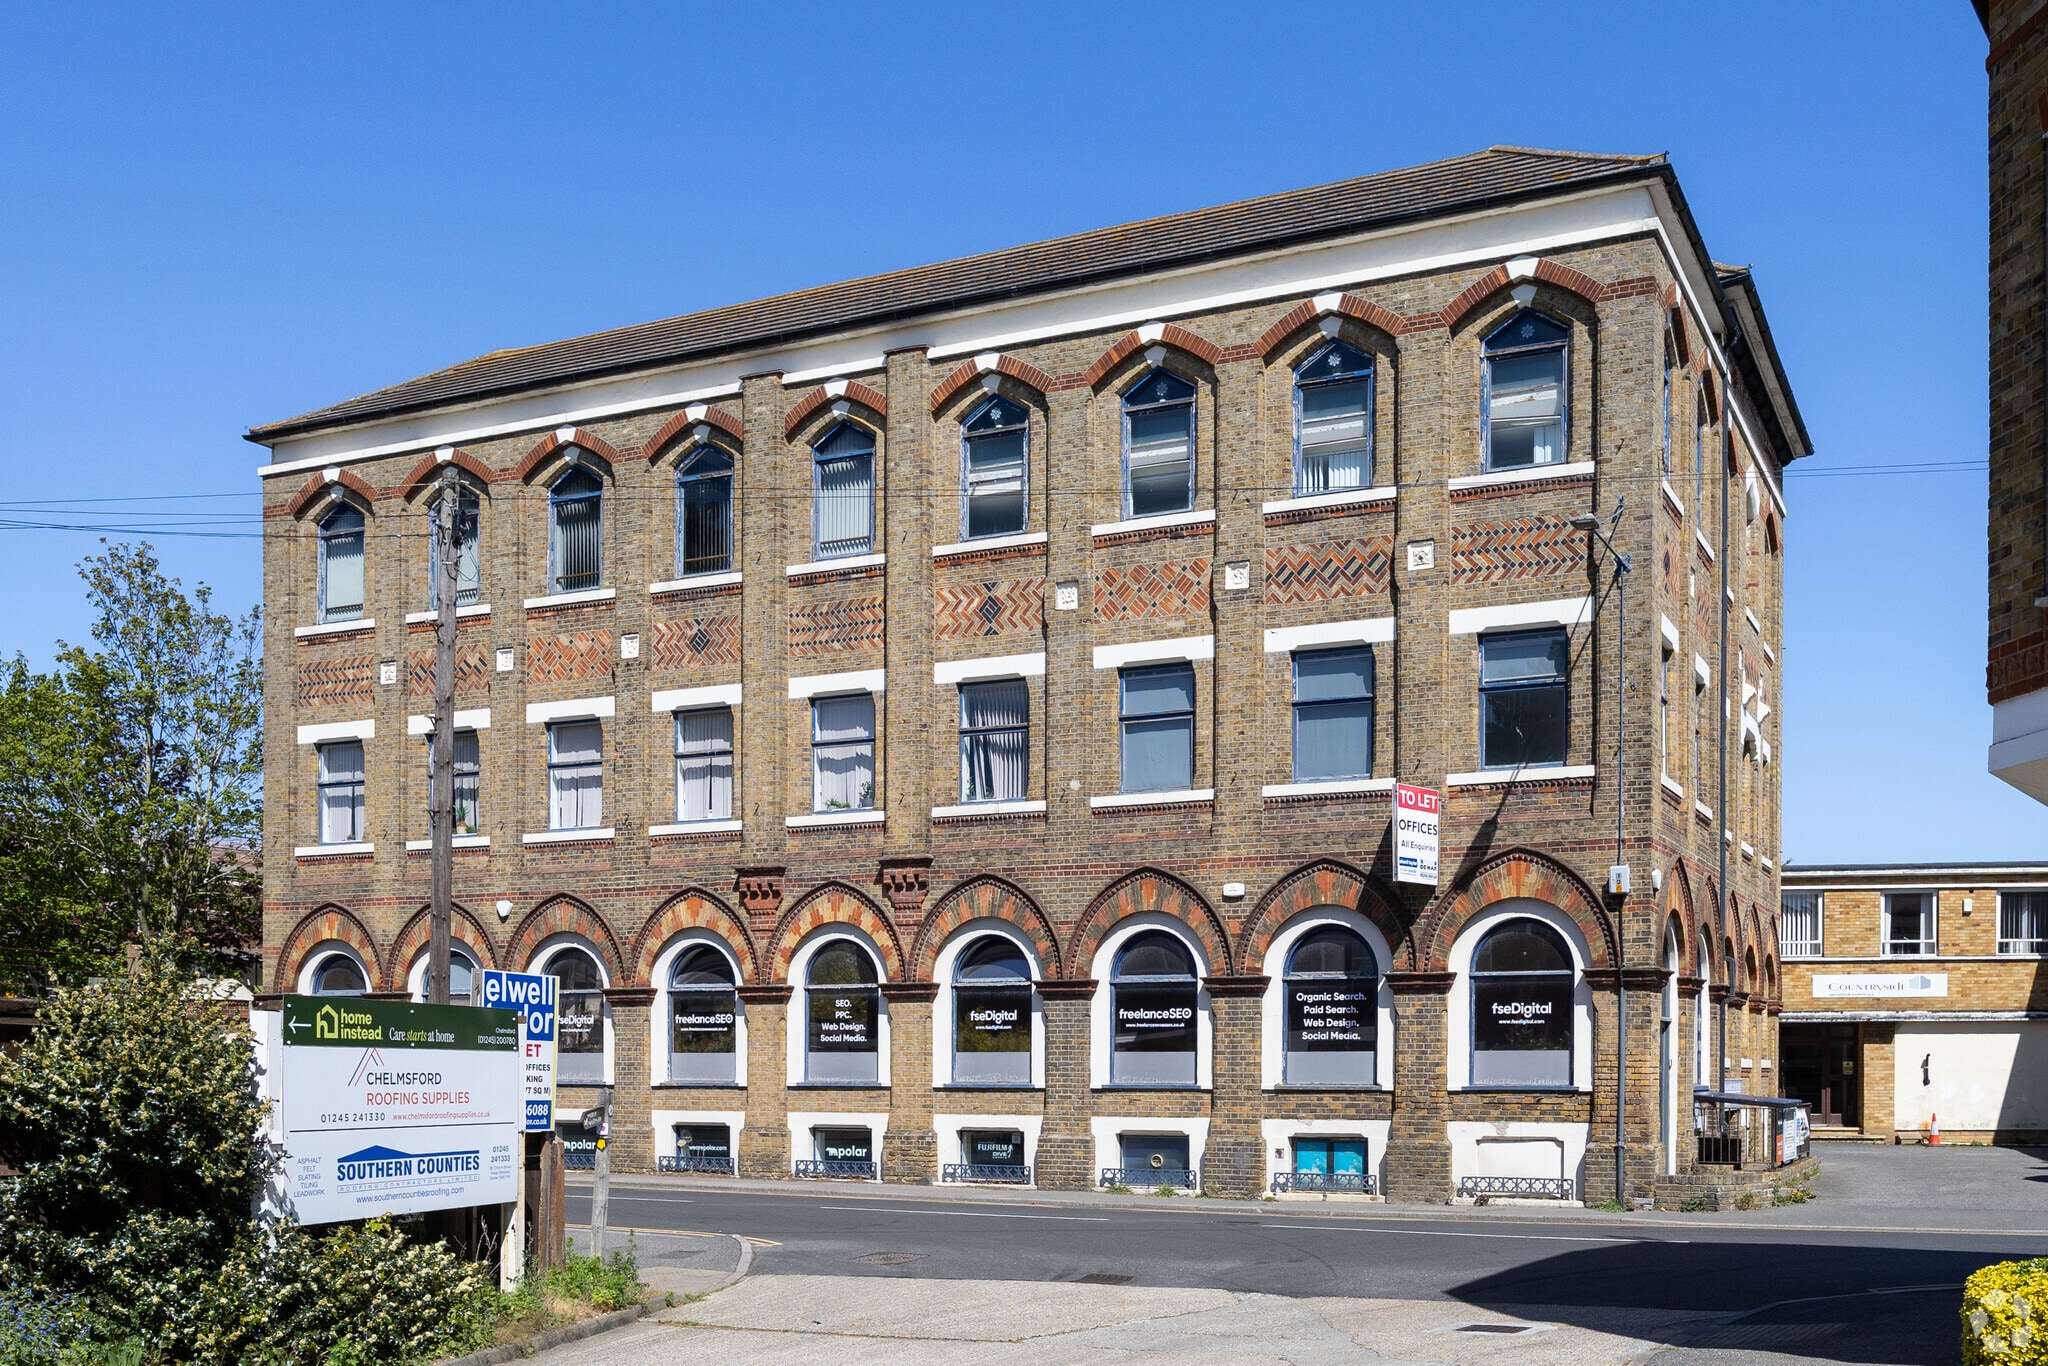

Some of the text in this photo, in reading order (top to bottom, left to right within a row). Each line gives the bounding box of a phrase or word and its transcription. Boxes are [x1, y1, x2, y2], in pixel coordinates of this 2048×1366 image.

[1399, 790, 1437, 809] TO LET
[1398, 819, 1438, 836] OFFICES
[1401, 840, 1436, 852] All Enquiries
[486, 972, 552, 1005] elwell
[1296, 992, 1366, 1002] Organic Search.
[341, 1008, 372, 1024] home
[1119, 1008, 1192, 1019] freelanceSEO
[1304, 1006, 1359, 1014] Paid Search.
[1492, 1002, 1552, 1018] fseDigital
[675, 1014, 733, 1024] freelanceSEO
[970, 1010, 1018, 1024] fseDigital
[1326, 1018, 1360, 1028] Design.
[341, 1024, 382, 1040] instead
[822, 1022, 866, 1032] Web Design.
[389, 1027, 455, 1042] Care starts at home
[478, 1035, 496, 1044] (01245)
[820, 1034, 867, 1042] Social Media.
[1302, 1032, 1360, 1040] Social Media.
[526, 1044, 542, 1058] ET
[366, 1072, 442, 1086] CHELMSFORD
[533, 1087, 542, 1095] SQ
[366, 1092, 470, 1106] ROOFING SUPPLIES
[392, 1111, 490, 1120] www.chelmsfordroofingsupplies.co.uk
[526, 1104, 549, 1116] 6088
[320, 1112, 386, 1123] 01245 241330
[838, 1145, 868, 1159] polar
[337, 1155, 480, 1181] SOUTHERN COUNTIES
[340, 1184, 379, 1192] ROOFING
[384, 1179, 443, 1188] CONTRACTORS
[294, 1189, 324, 1198] LEADWORK
[356, 1186, 464, 1203] www.southerncountiesroofing.com
